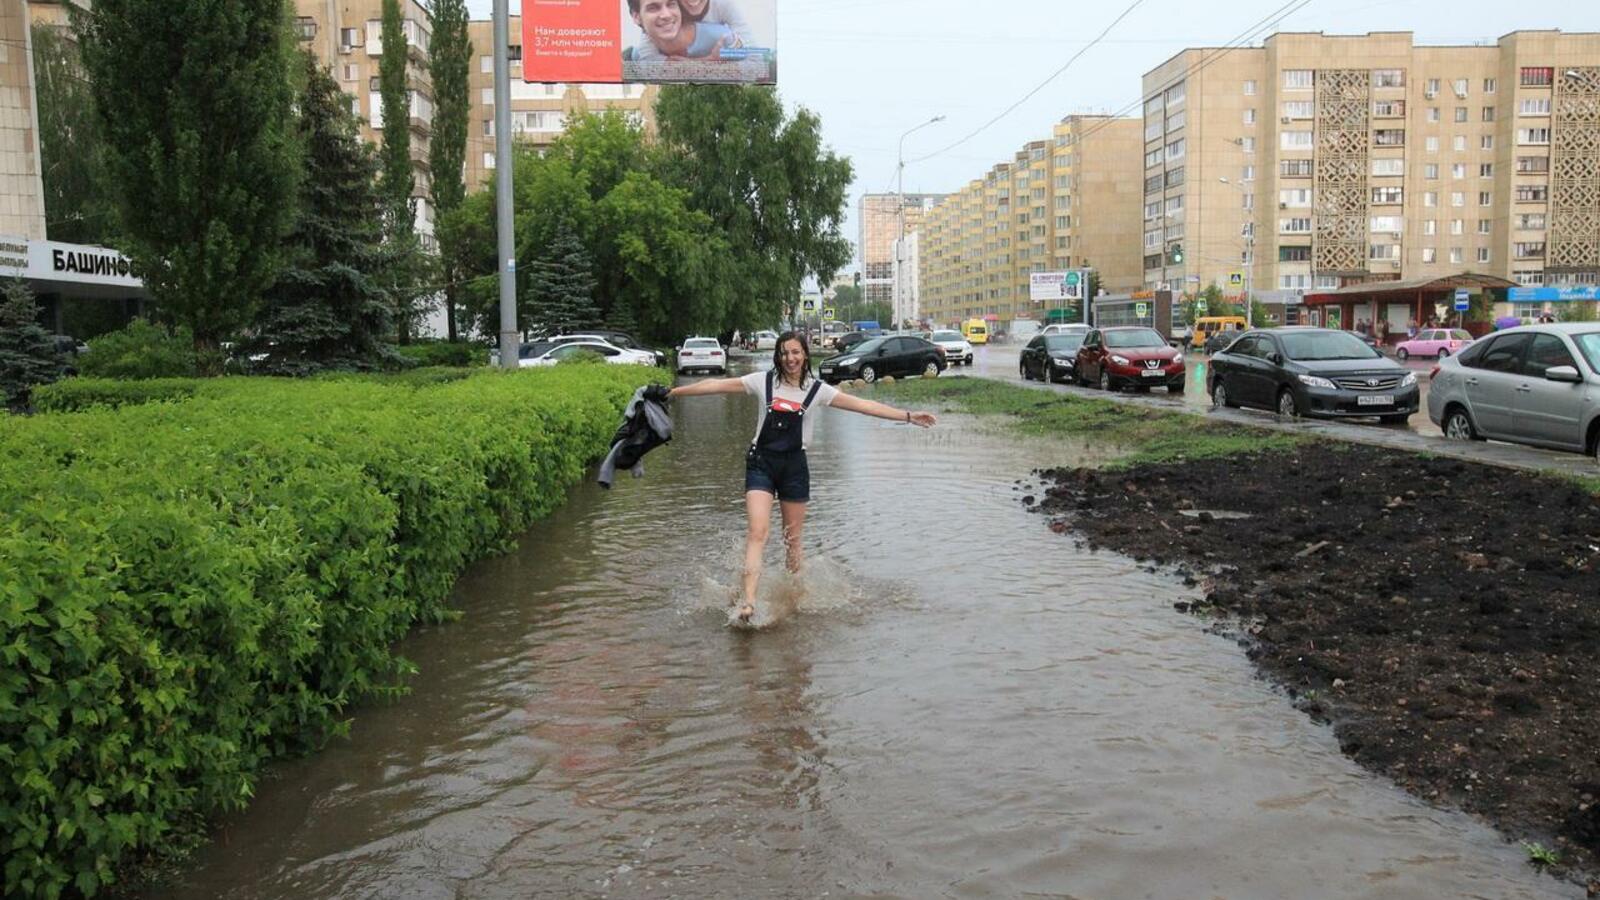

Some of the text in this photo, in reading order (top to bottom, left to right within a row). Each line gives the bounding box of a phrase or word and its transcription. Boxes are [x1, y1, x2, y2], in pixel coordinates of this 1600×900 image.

[535, 26, 606, 38] Нам доверяют
[535, 36, 615, 48] 3,7 млн человек
[52, 249, 149, 279] БАШИНФО
